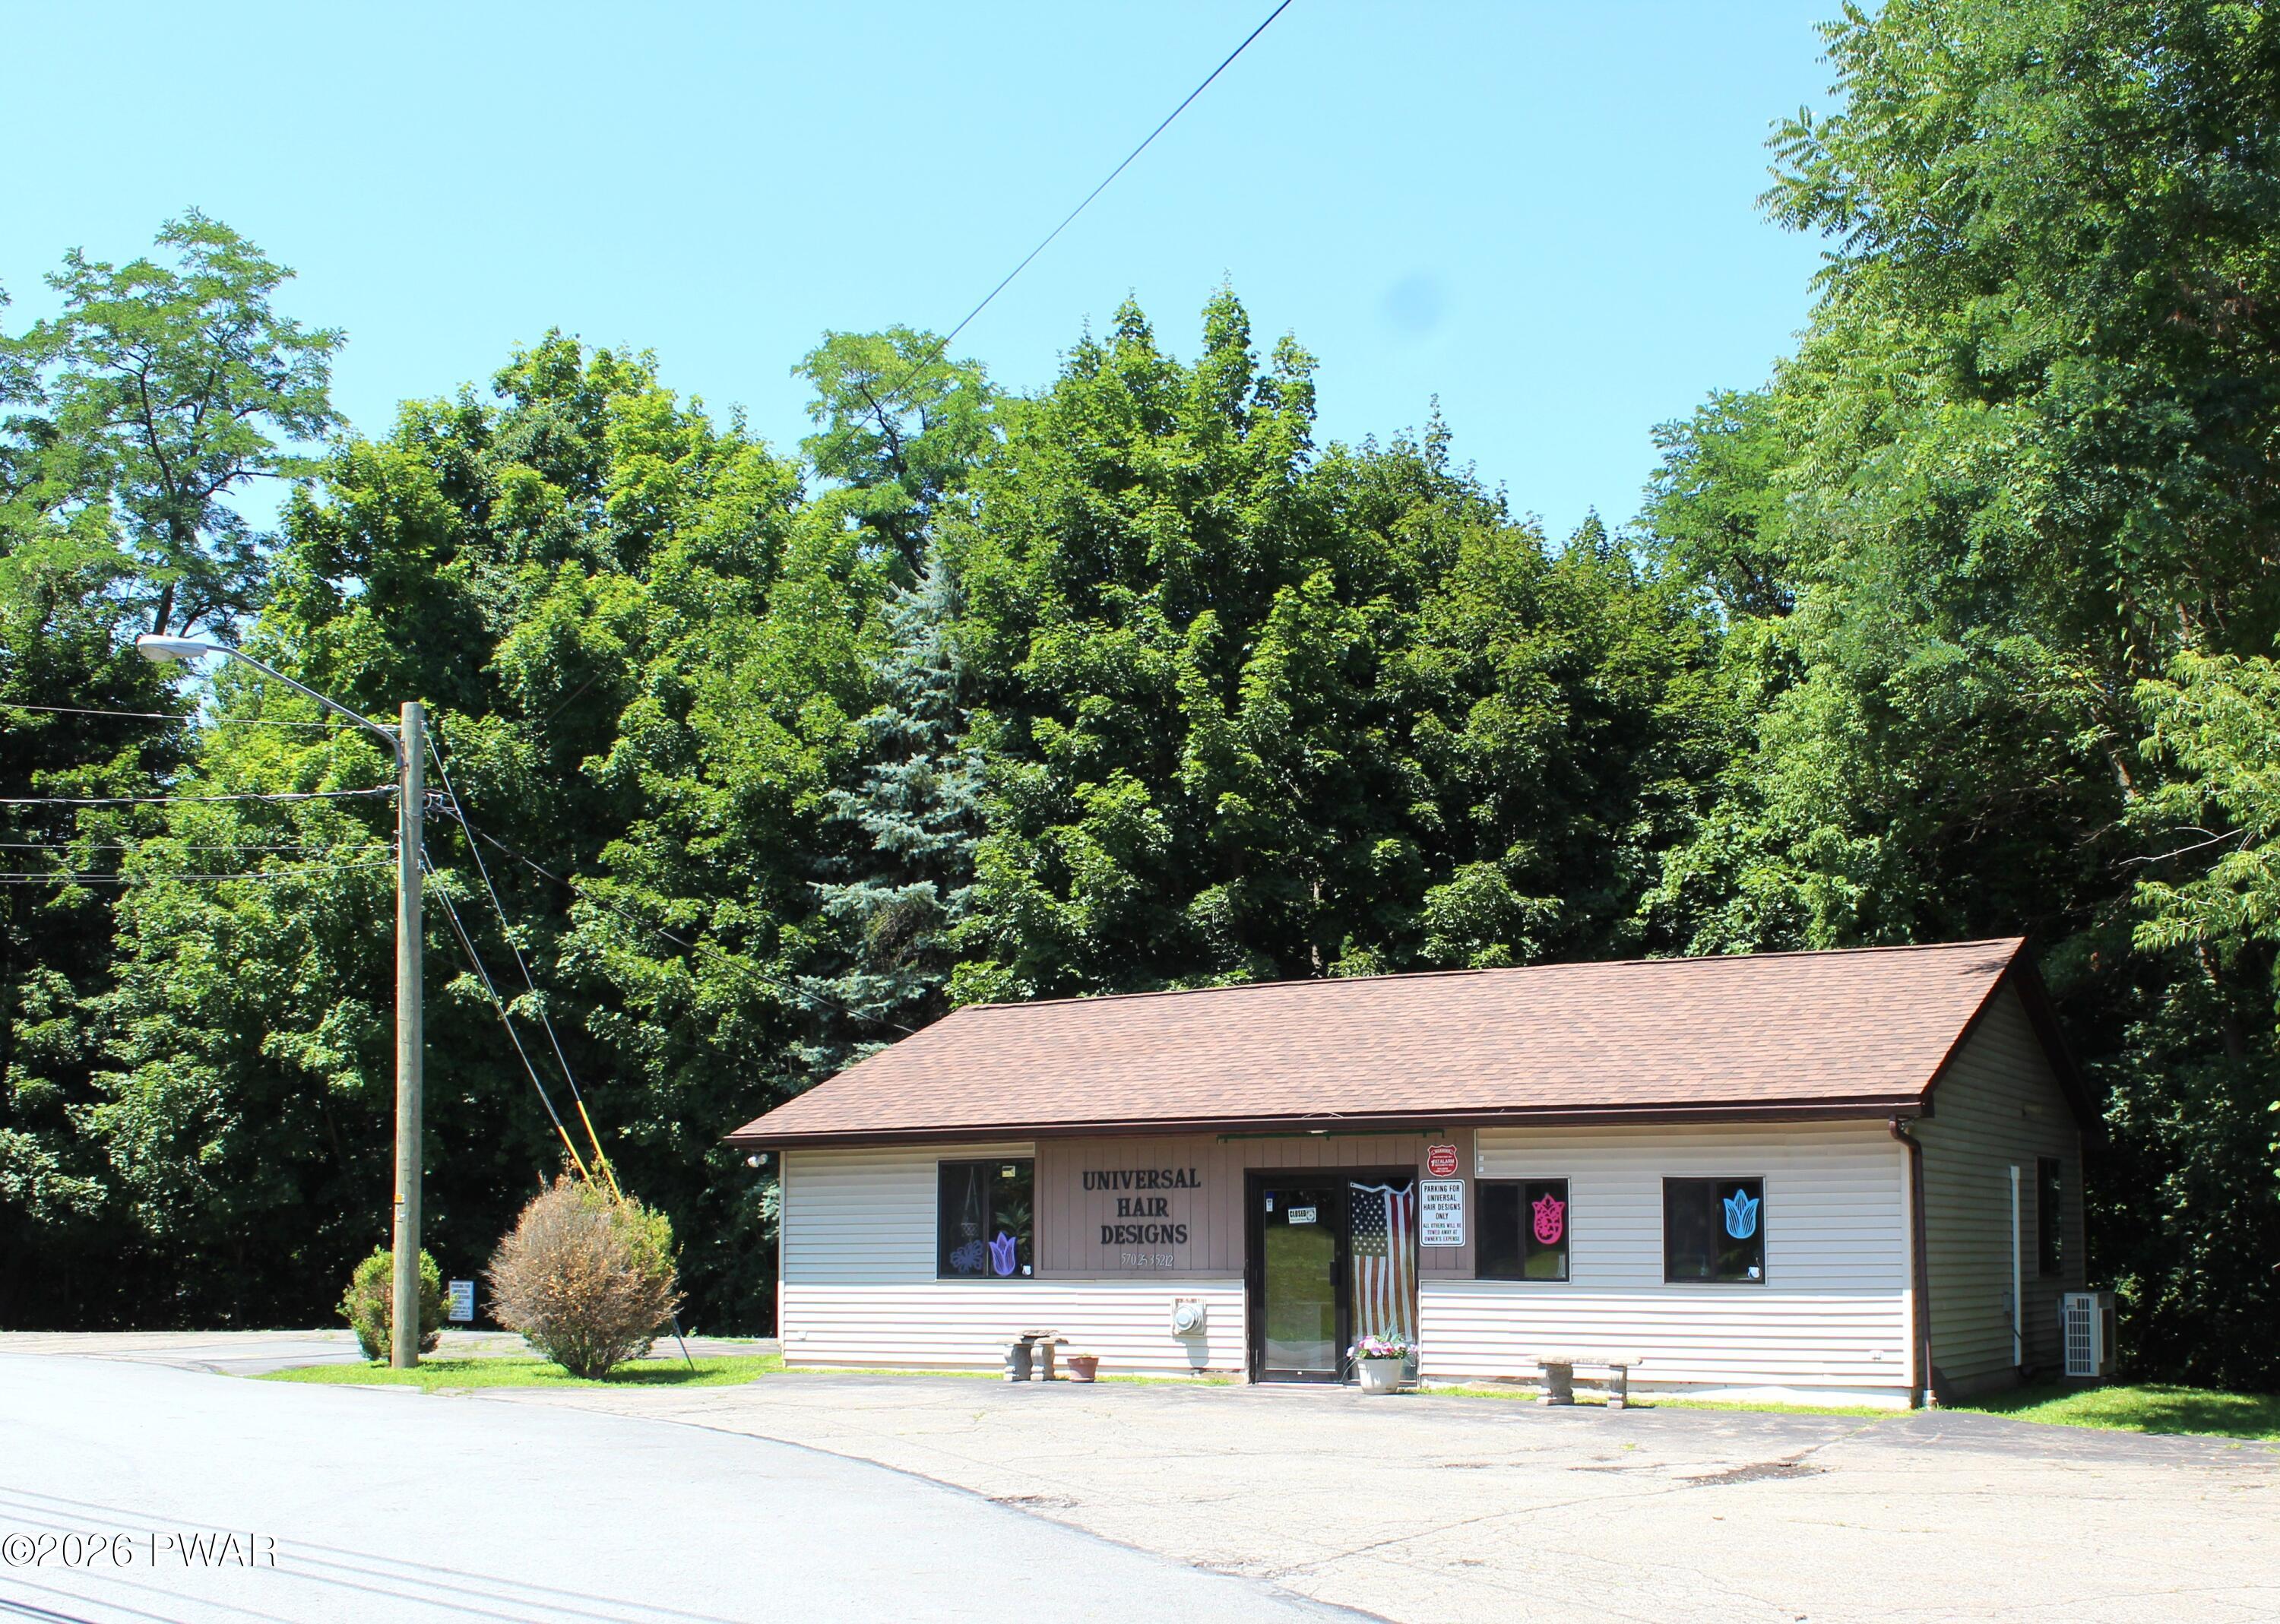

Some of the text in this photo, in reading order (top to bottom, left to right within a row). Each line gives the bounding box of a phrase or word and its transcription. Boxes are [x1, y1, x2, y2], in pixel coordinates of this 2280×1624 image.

[1082, 1168, 1201, 1191] UNIVERSAL
[1117, 1197, 1169, 1217] HAIR
[1100, 1224, 1188, 1245] DESIGNS
